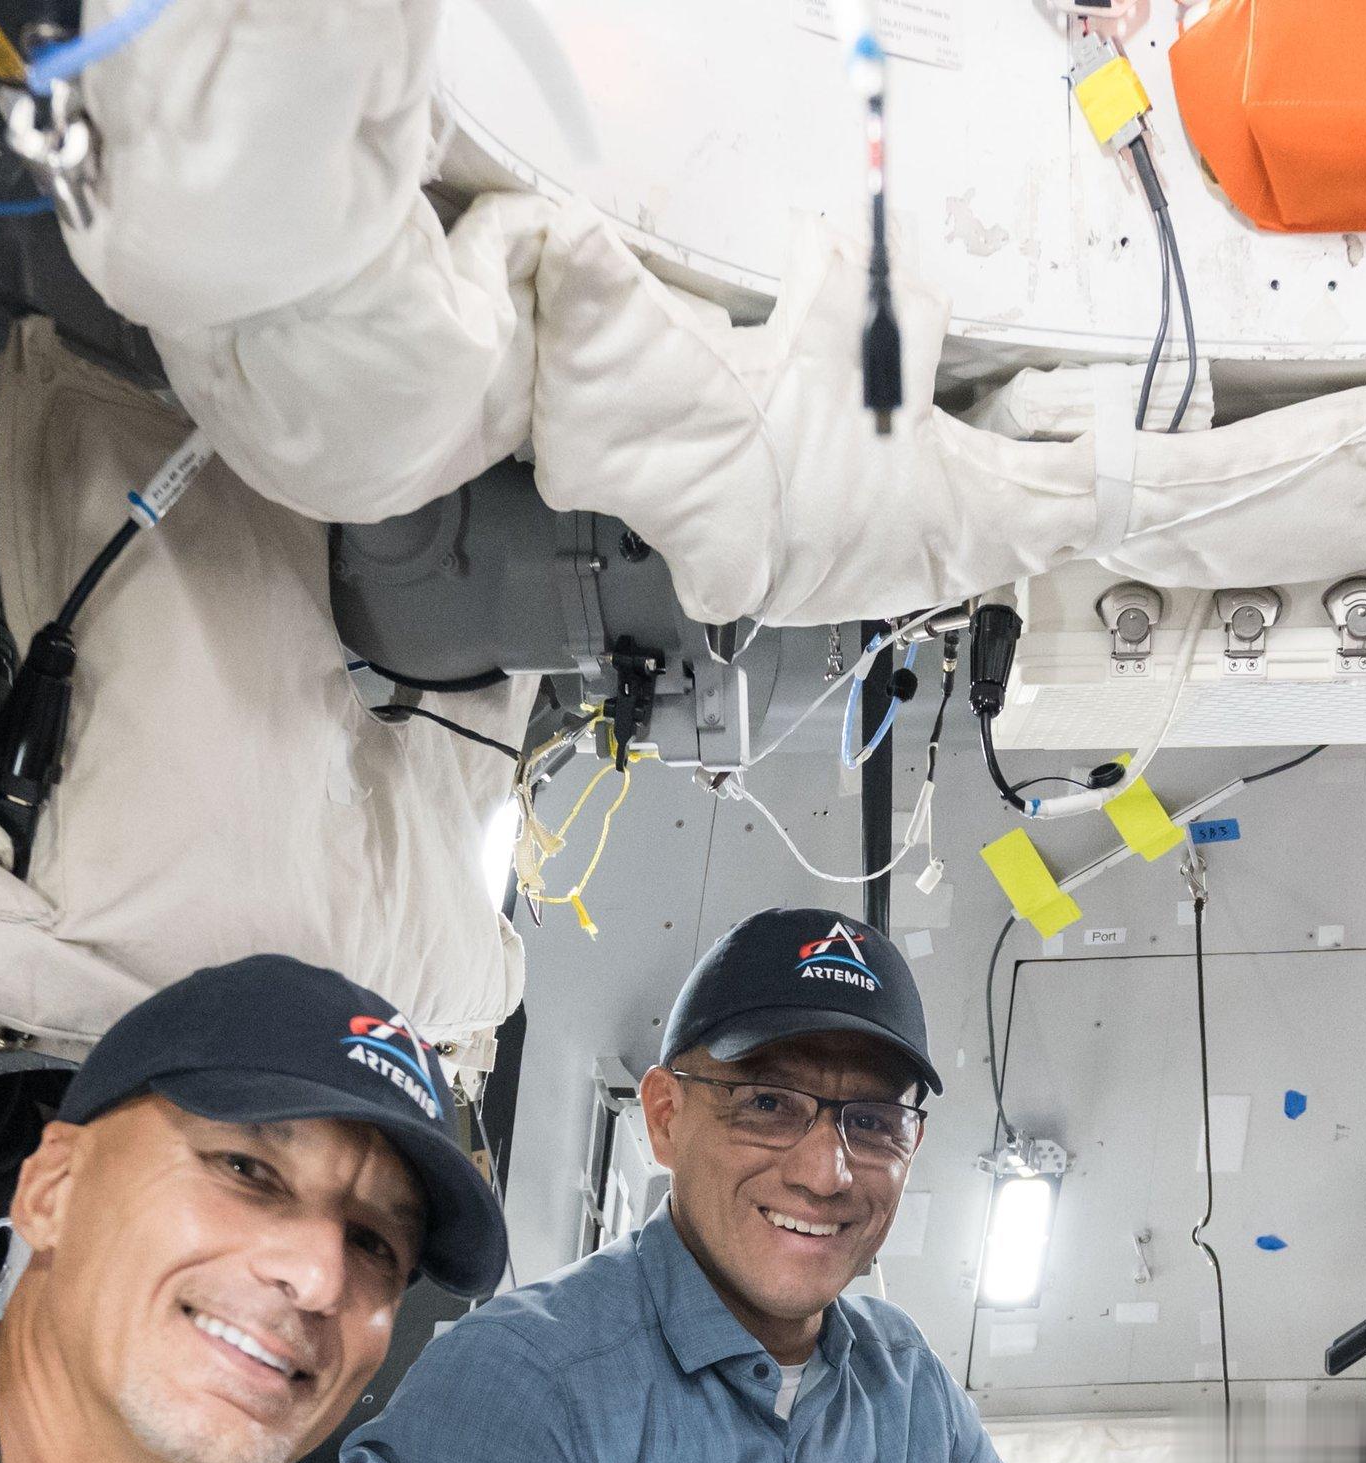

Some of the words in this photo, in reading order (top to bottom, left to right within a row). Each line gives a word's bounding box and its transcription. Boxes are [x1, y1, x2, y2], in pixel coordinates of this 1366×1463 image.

[1092, 931, 1117, 943] Port
[801, 965, 875, 991] ARTEMIS
[347, 1043, 436, 1120] ARTEMIS
